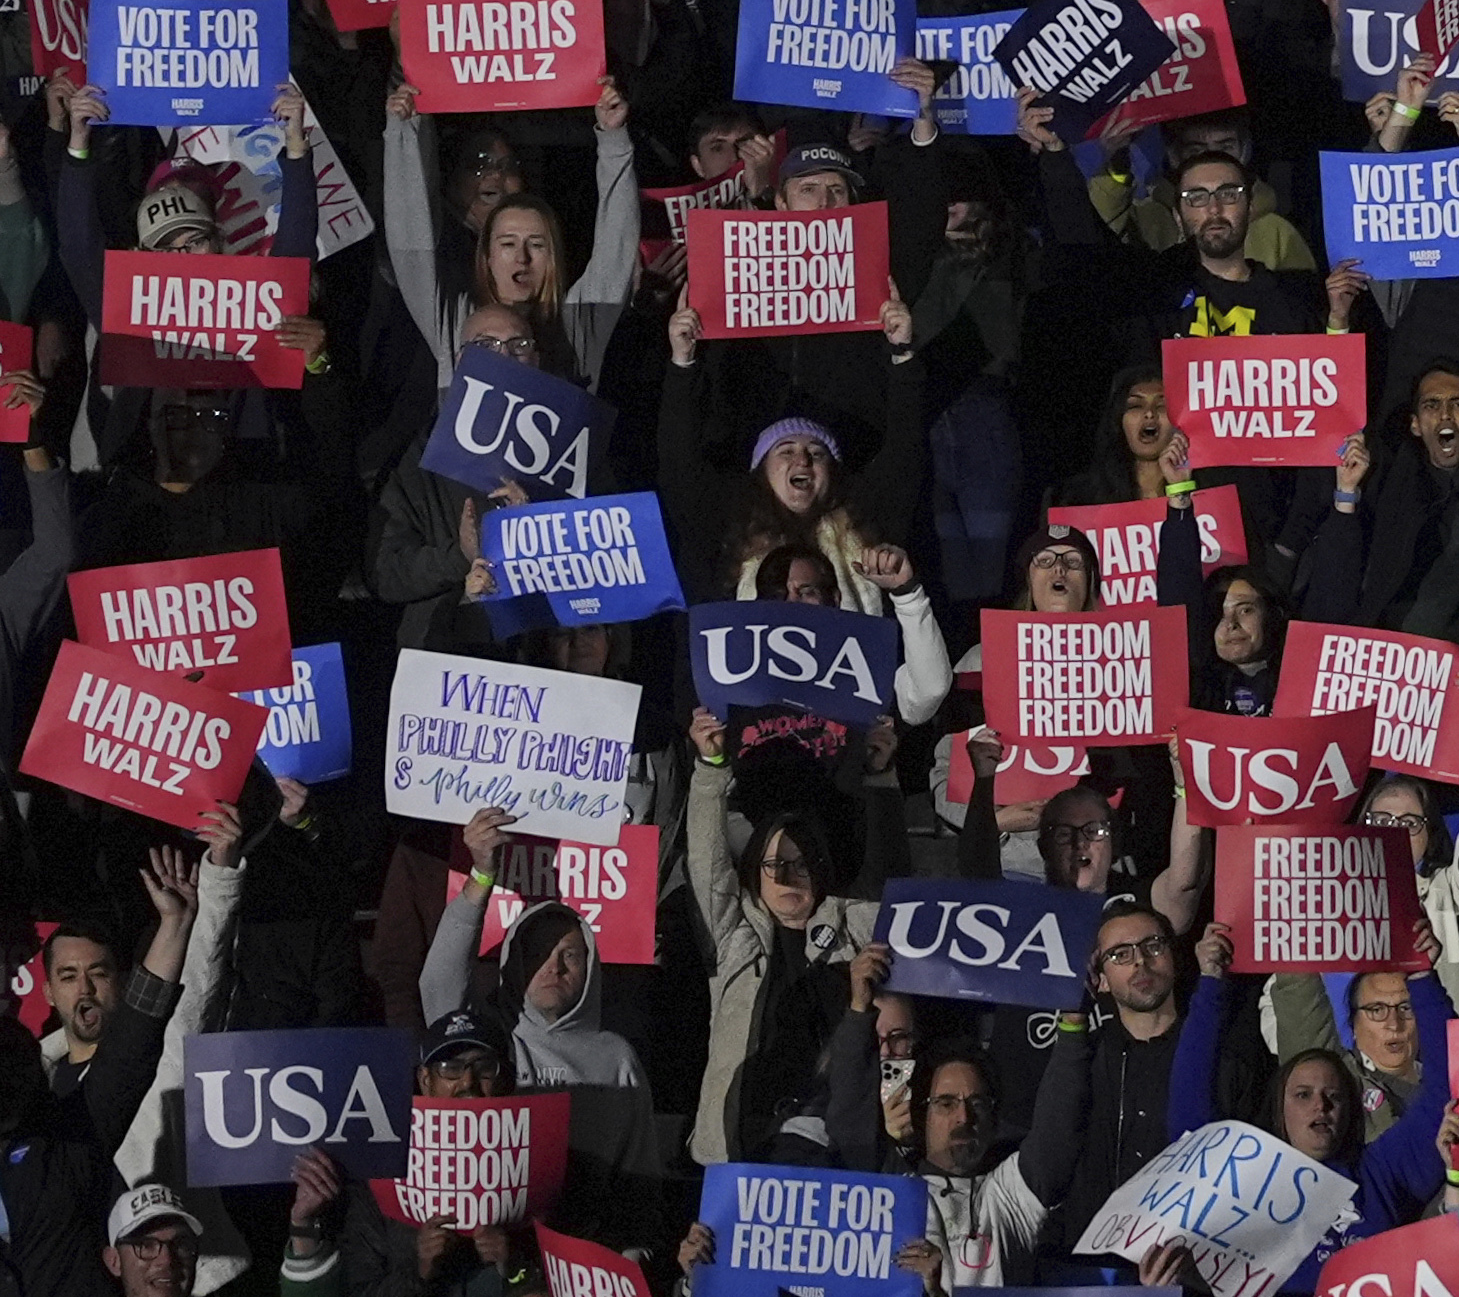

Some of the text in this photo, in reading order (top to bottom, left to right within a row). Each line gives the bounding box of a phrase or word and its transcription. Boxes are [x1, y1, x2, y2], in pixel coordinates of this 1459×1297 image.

[118, 6, 257, 48] VOTE FOR
[427, 0, 576, 52] HARRIS
[117, 47, 258, 87] FREEDOM
[451, 53, 556, 83] WALZ
[1060, 43, 1134, 105] WALZ
[1350, 164, 1425, 203] VOTE
[148, 195, 197, 224] PHL
[1409, 250, 1441, 261] HARRIS
[131, 276, 282, 330] HARRIS
[153, 331, 257, 360] WALZ
[101, 578, 256, 642] HARRIS
[133, 635, 238, 671] WALZ
[1018, 621, 1150, 660] FREEDOM
[440, 671, 550, 723] WHEN
[1019, 659, 1151, 698] FREEDOM
[1020, 694, 1152, 736] FREEDOM
[400, 714, 512, 763] PHILLY
[194, 1066, 399, 1148] USA
[1147, 1127, 1318, 1224] HARRIS
